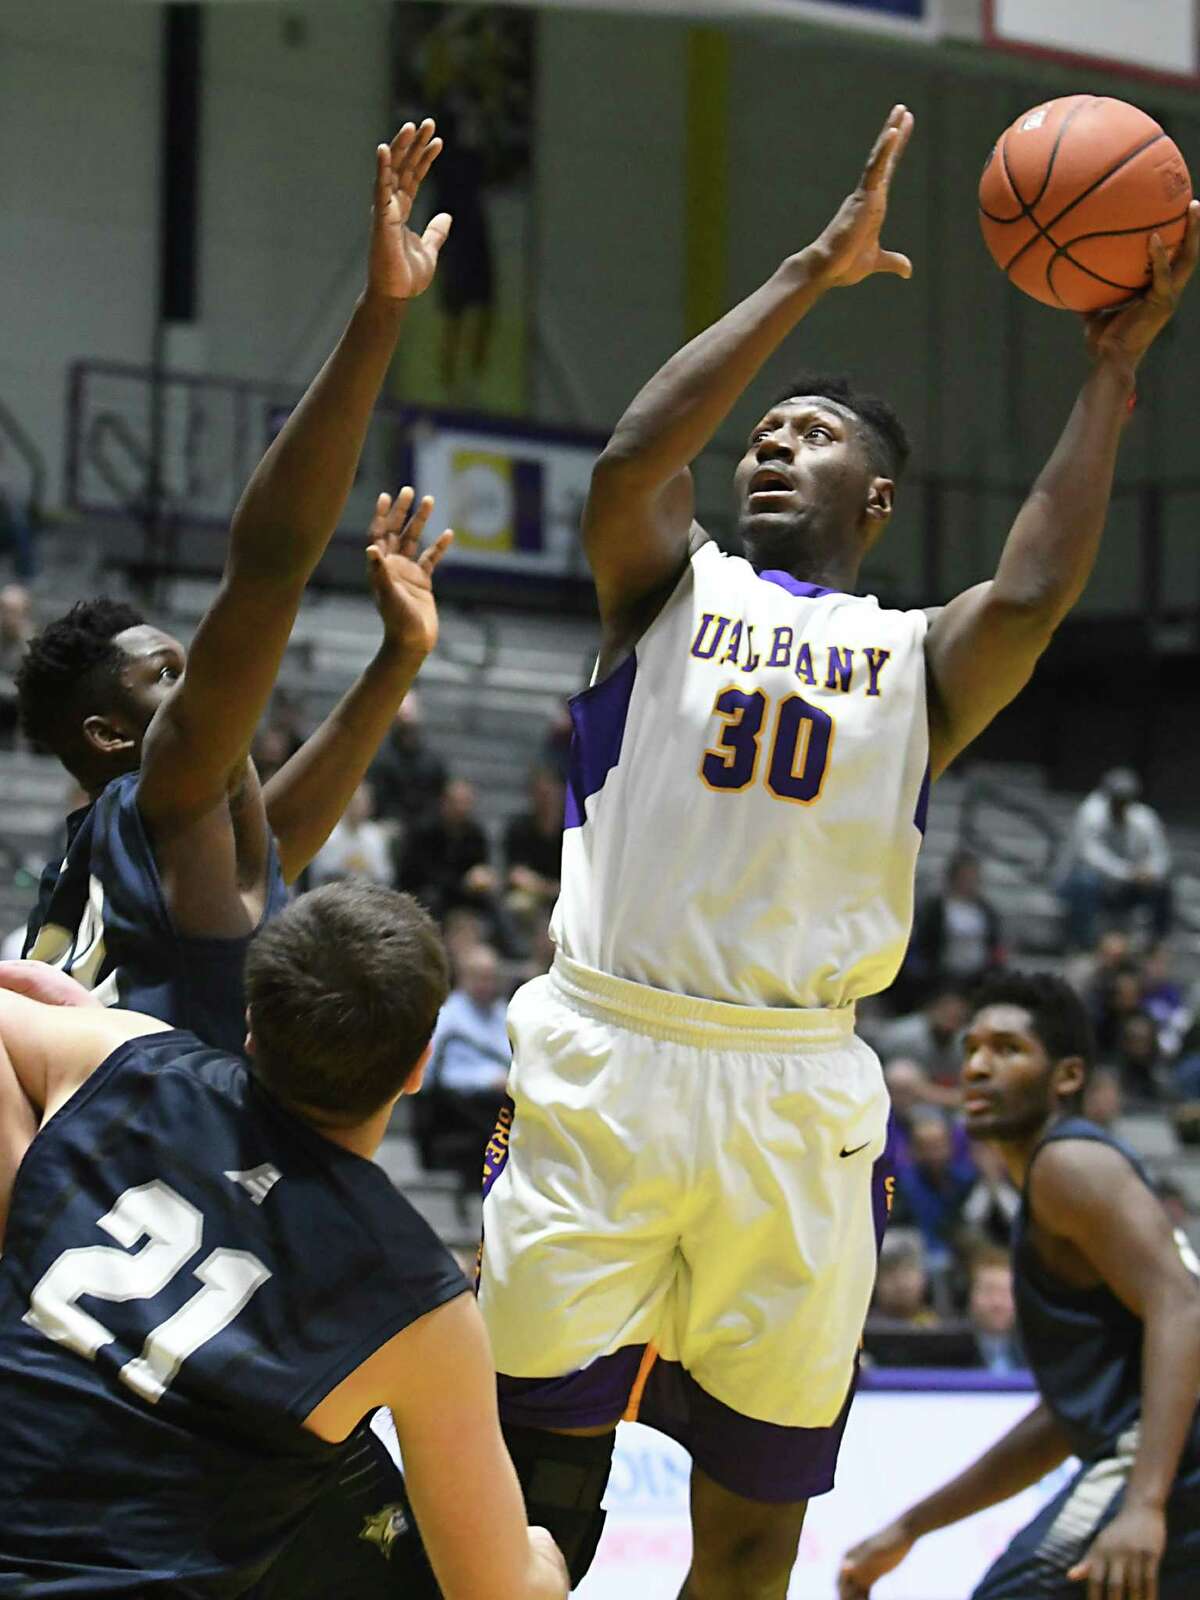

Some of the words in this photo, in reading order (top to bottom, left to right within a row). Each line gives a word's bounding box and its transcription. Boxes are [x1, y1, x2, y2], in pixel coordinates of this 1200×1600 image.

[690, 613, 892, 697] UALBANY
[698, 684, 837, 807] 30
[21, 1178, 273, 1404] 21
